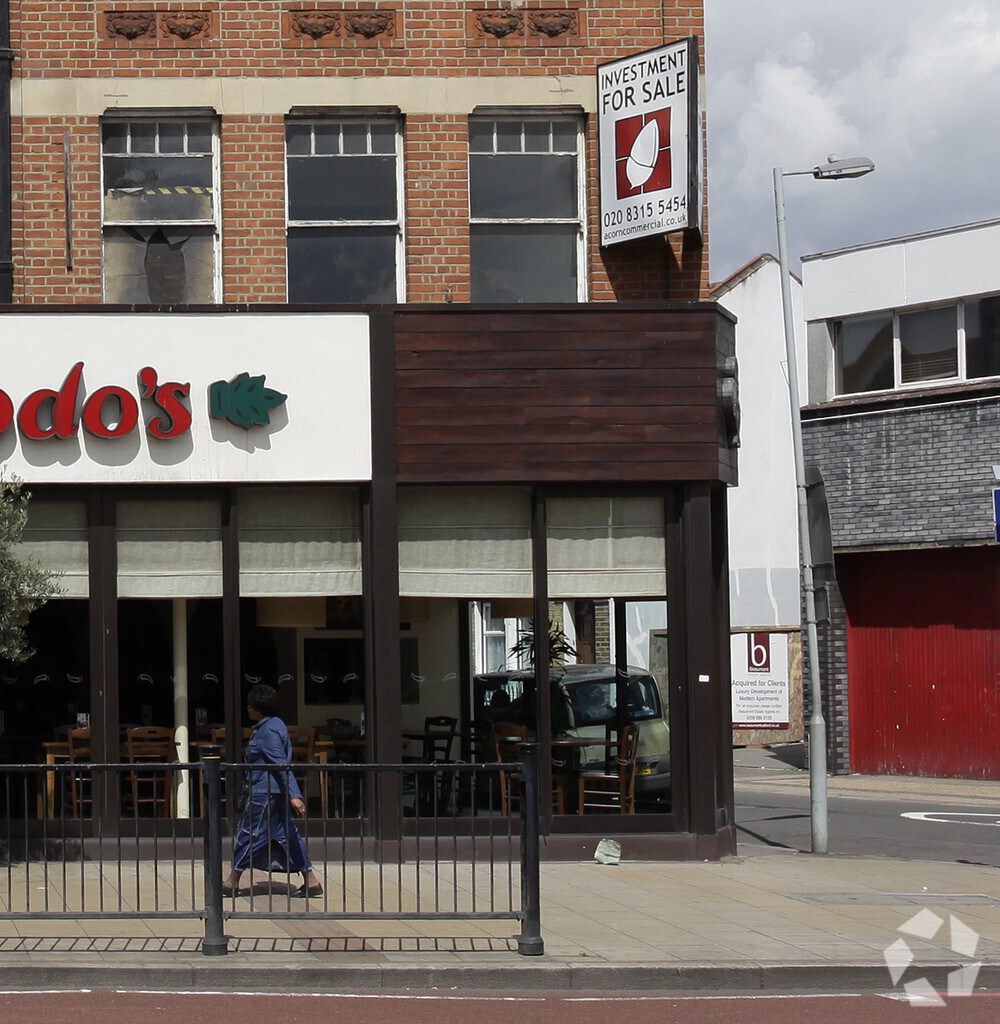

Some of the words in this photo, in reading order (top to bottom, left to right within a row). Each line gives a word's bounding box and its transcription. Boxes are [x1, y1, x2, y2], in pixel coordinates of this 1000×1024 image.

[602, 49, 686, 90] INVESTMENT
[603, 86, 636, 114] FOR
[643, 71, 685, 103] SALE
[604, 210, 623, 228] 020
[626, 202, 653, 222] 8315
[658, 195, 687, 215] 5454
[604, 214, 687, 240] acorncommercial.co.uk
[732, 679, 757, 687] Acquired
[767, 679, 786, 687] Clients
